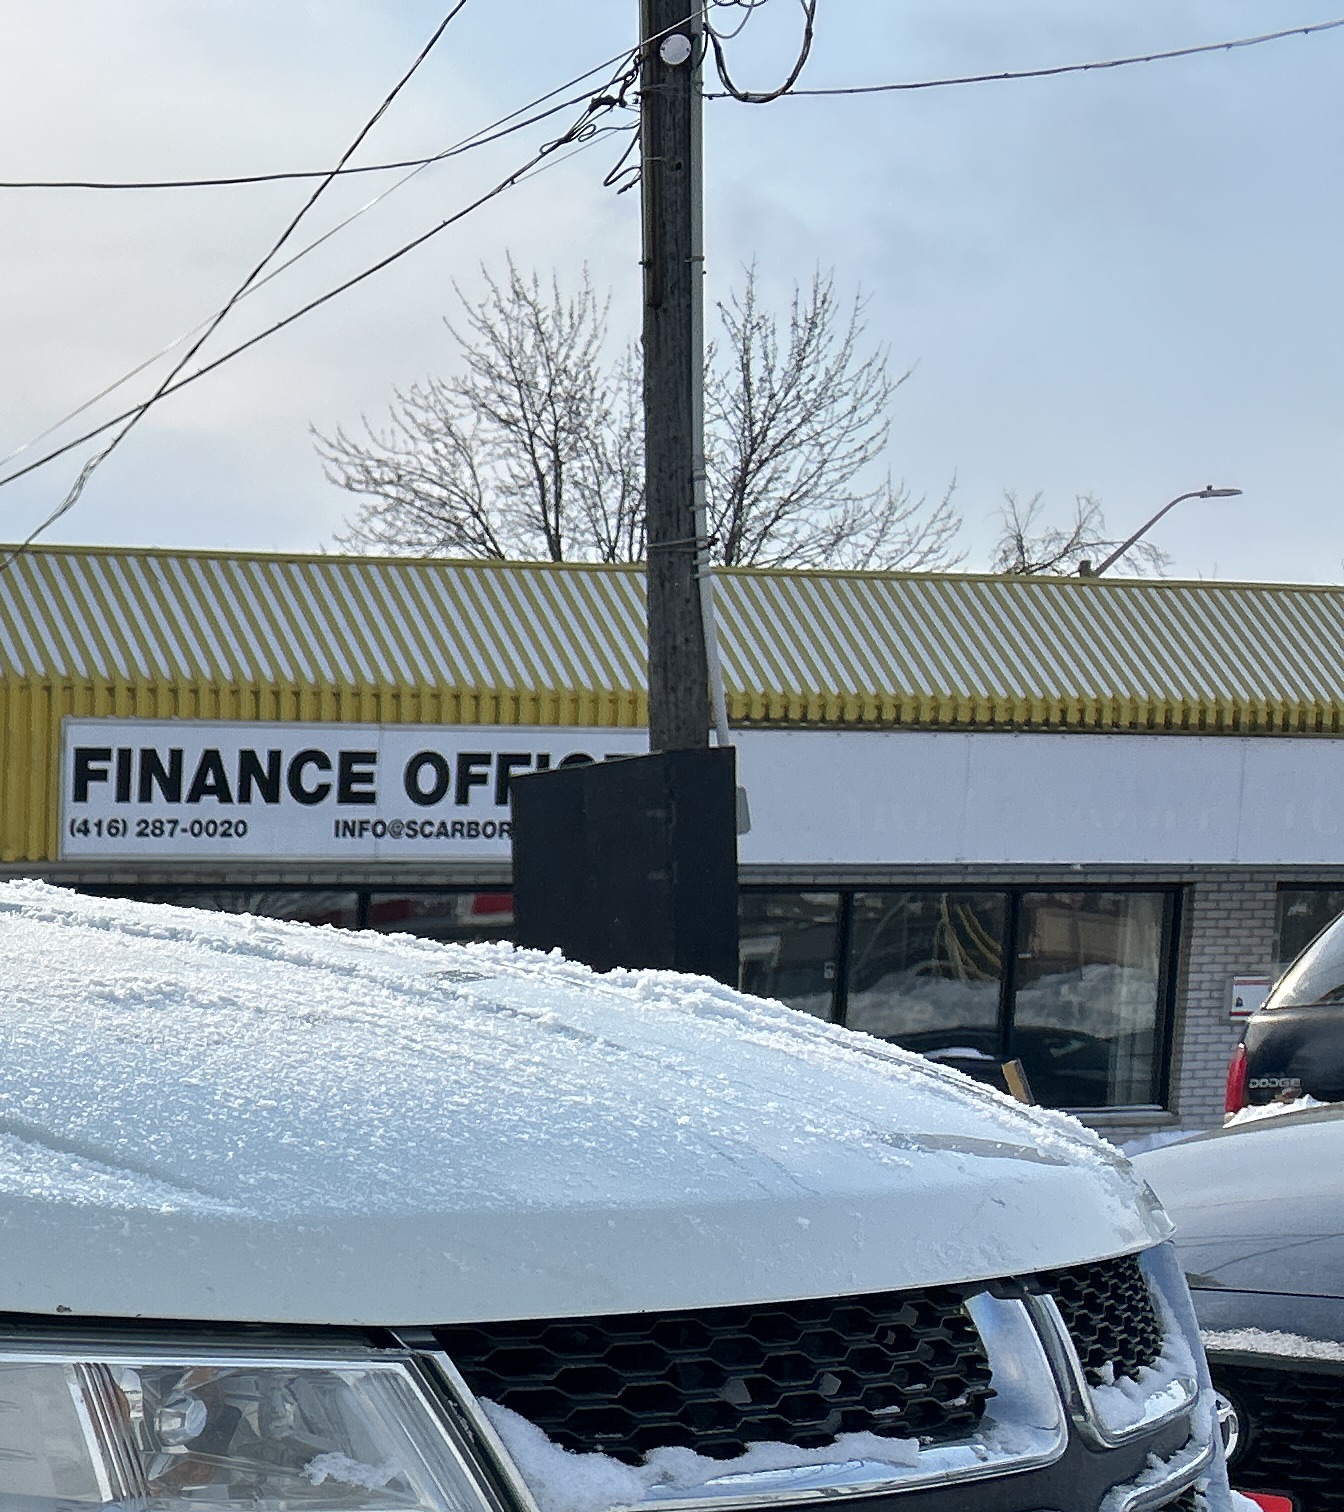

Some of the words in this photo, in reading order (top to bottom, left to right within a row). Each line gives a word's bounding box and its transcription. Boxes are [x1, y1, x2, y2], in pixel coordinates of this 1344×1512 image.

[73, 747, 378, 805] FINANCE
[69, 817, 127, 839] (416)
[135, 818, 248, 839] 287-0020
[334, 819, 512, 839] INFO@SCARBOR
[1249, 1078, 1300, 1088] DODGE
